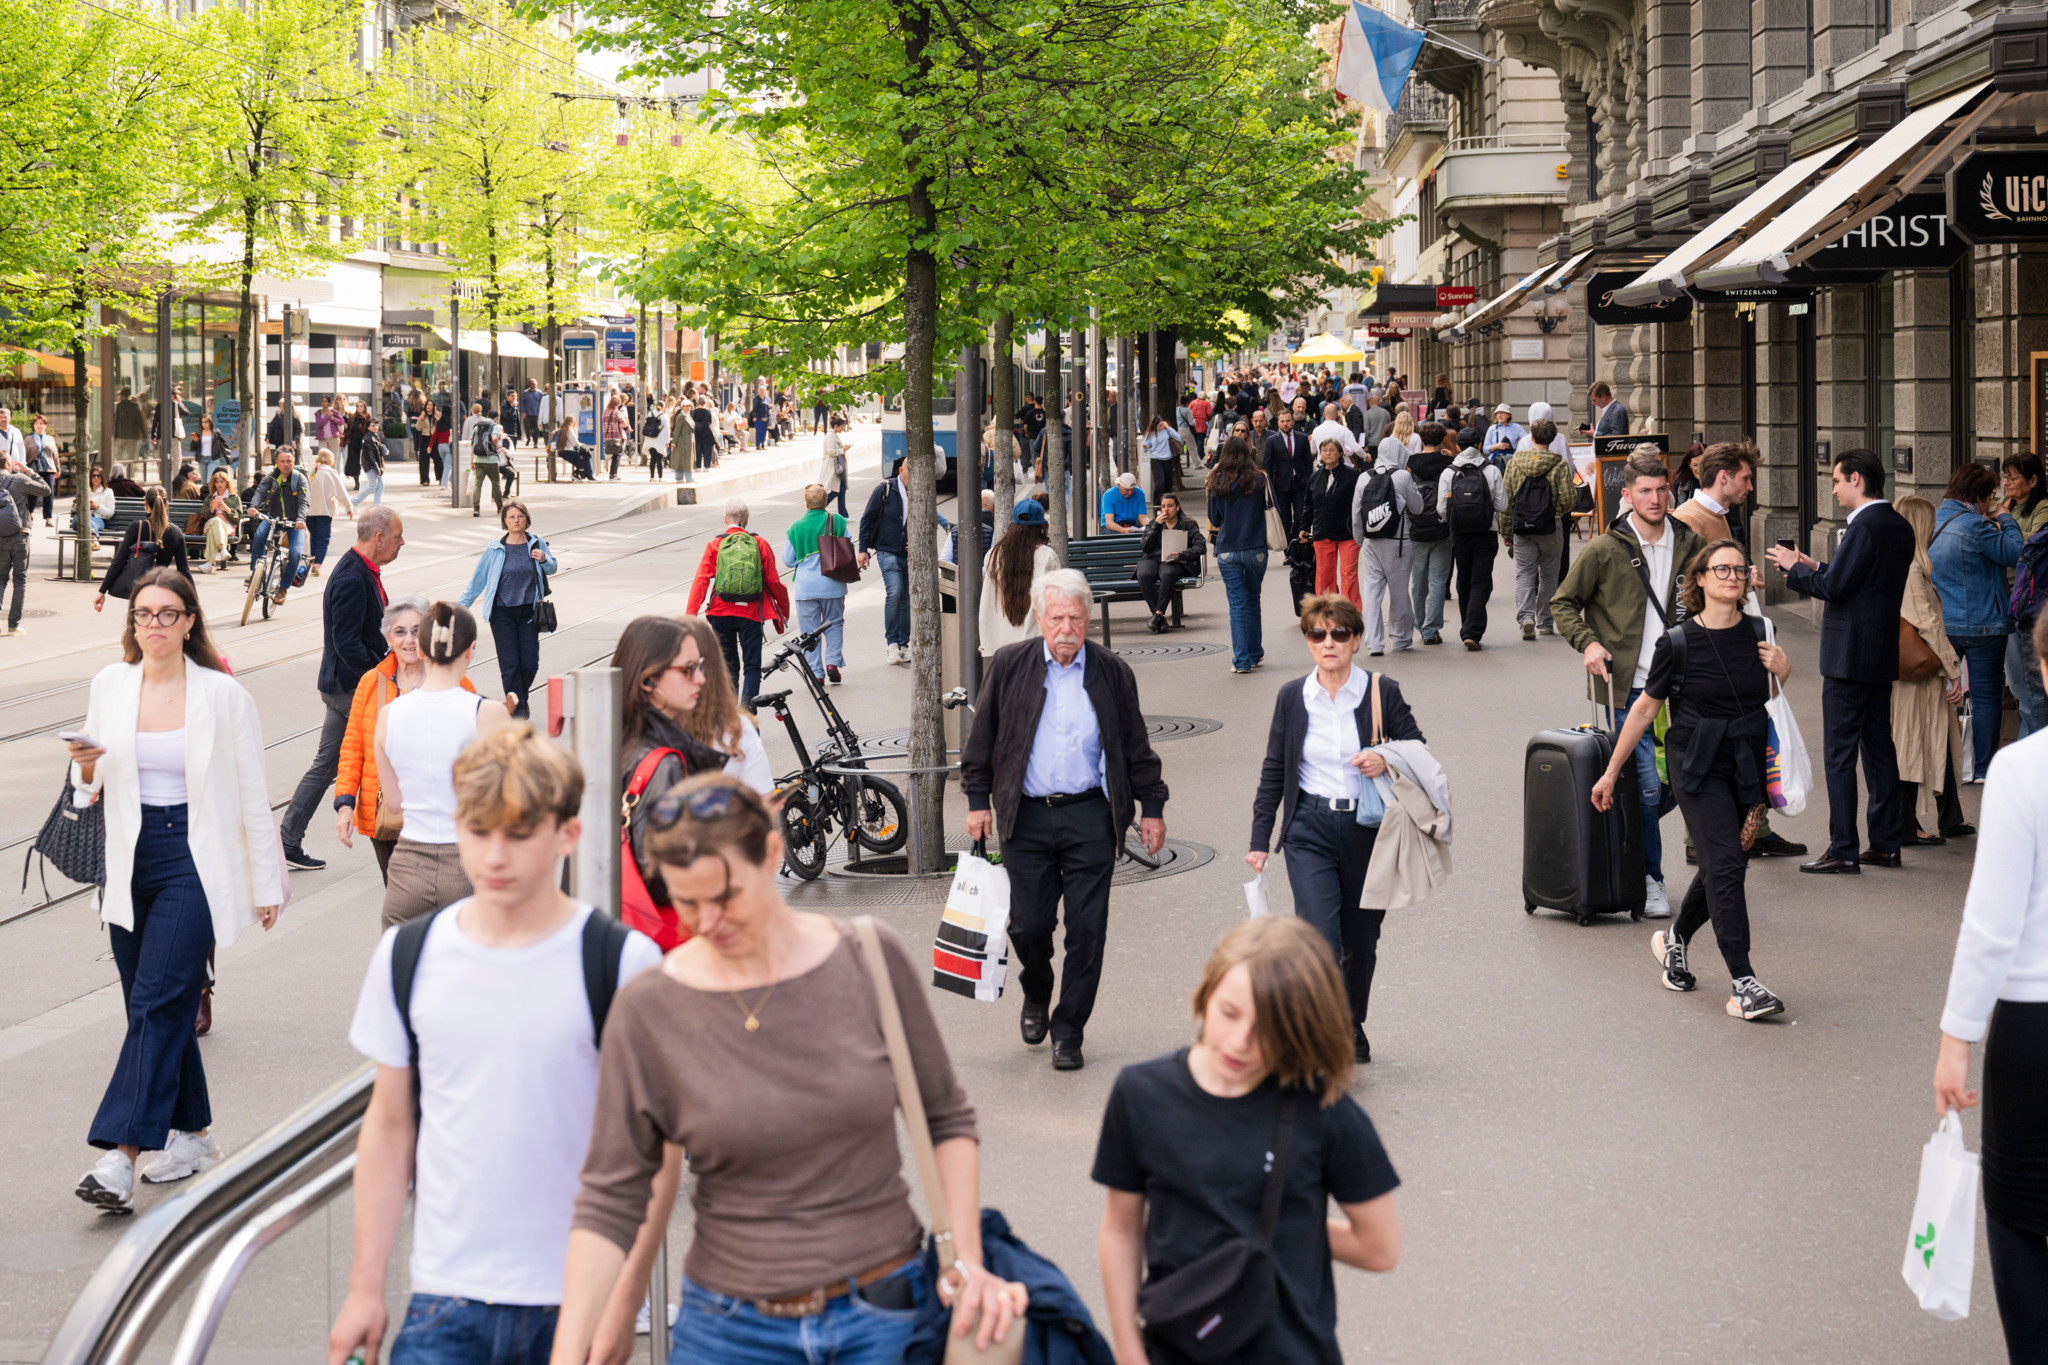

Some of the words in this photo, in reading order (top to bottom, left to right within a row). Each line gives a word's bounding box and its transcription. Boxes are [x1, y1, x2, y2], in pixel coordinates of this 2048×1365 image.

[1447, 292, 1473, 300] Sunrise
[388, 335, 416, 345] GÖTTE
[1368, 501, 1390, 525] NIKE
